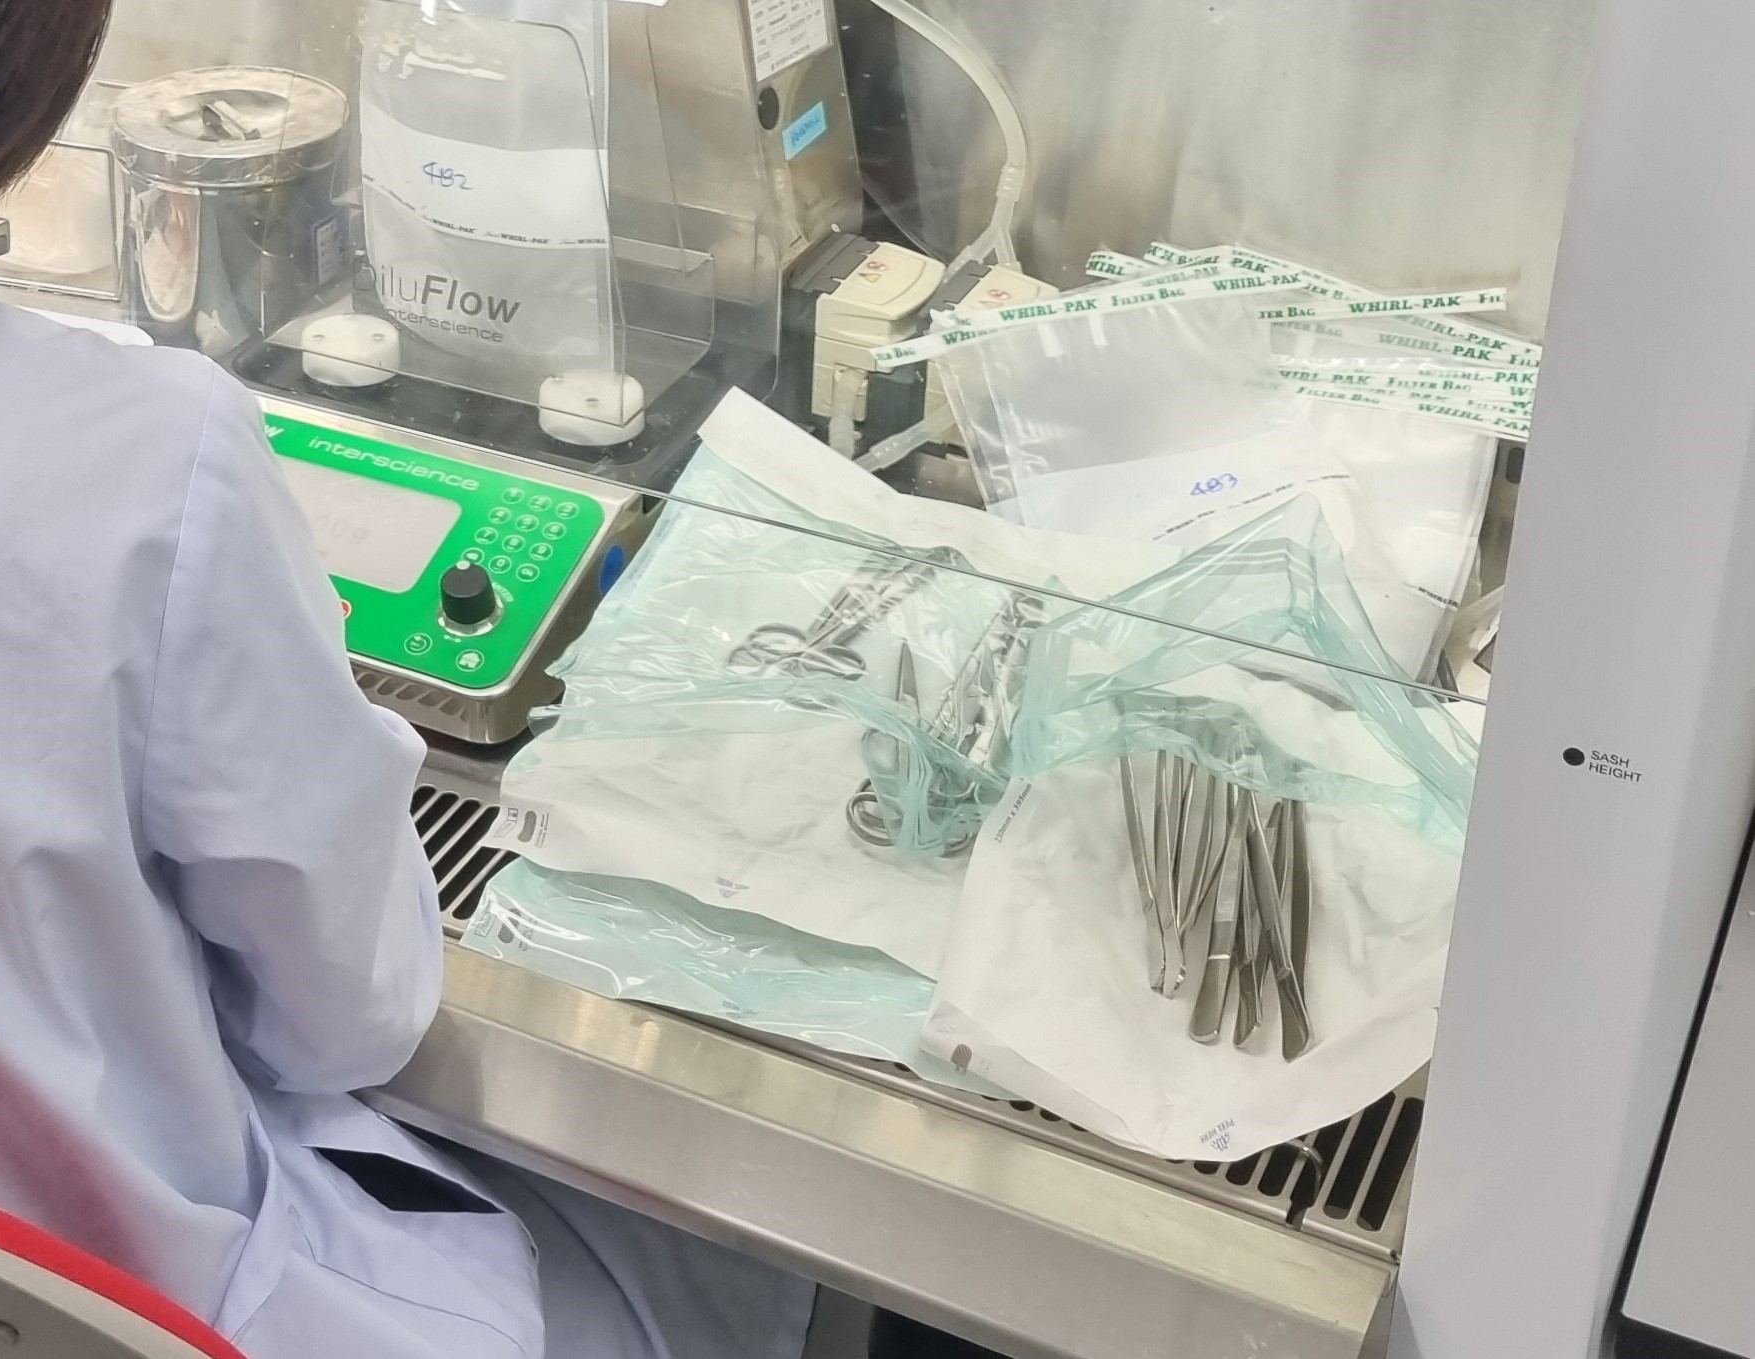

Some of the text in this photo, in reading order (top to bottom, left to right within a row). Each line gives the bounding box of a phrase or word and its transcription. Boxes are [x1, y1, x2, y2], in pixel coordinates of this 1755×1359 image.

[999, 297, 1098, 322] WHIRL-PAK
[1212, 272, 1301, 292] WHIRL-PAK
[1349, 295, 1462, 314] WHIRL-PAK
[308, 435, 480, 491] interscience
[1590, 750, 1630, 768] SASH
[1588, 762, 1643, 783] HEIGHT
